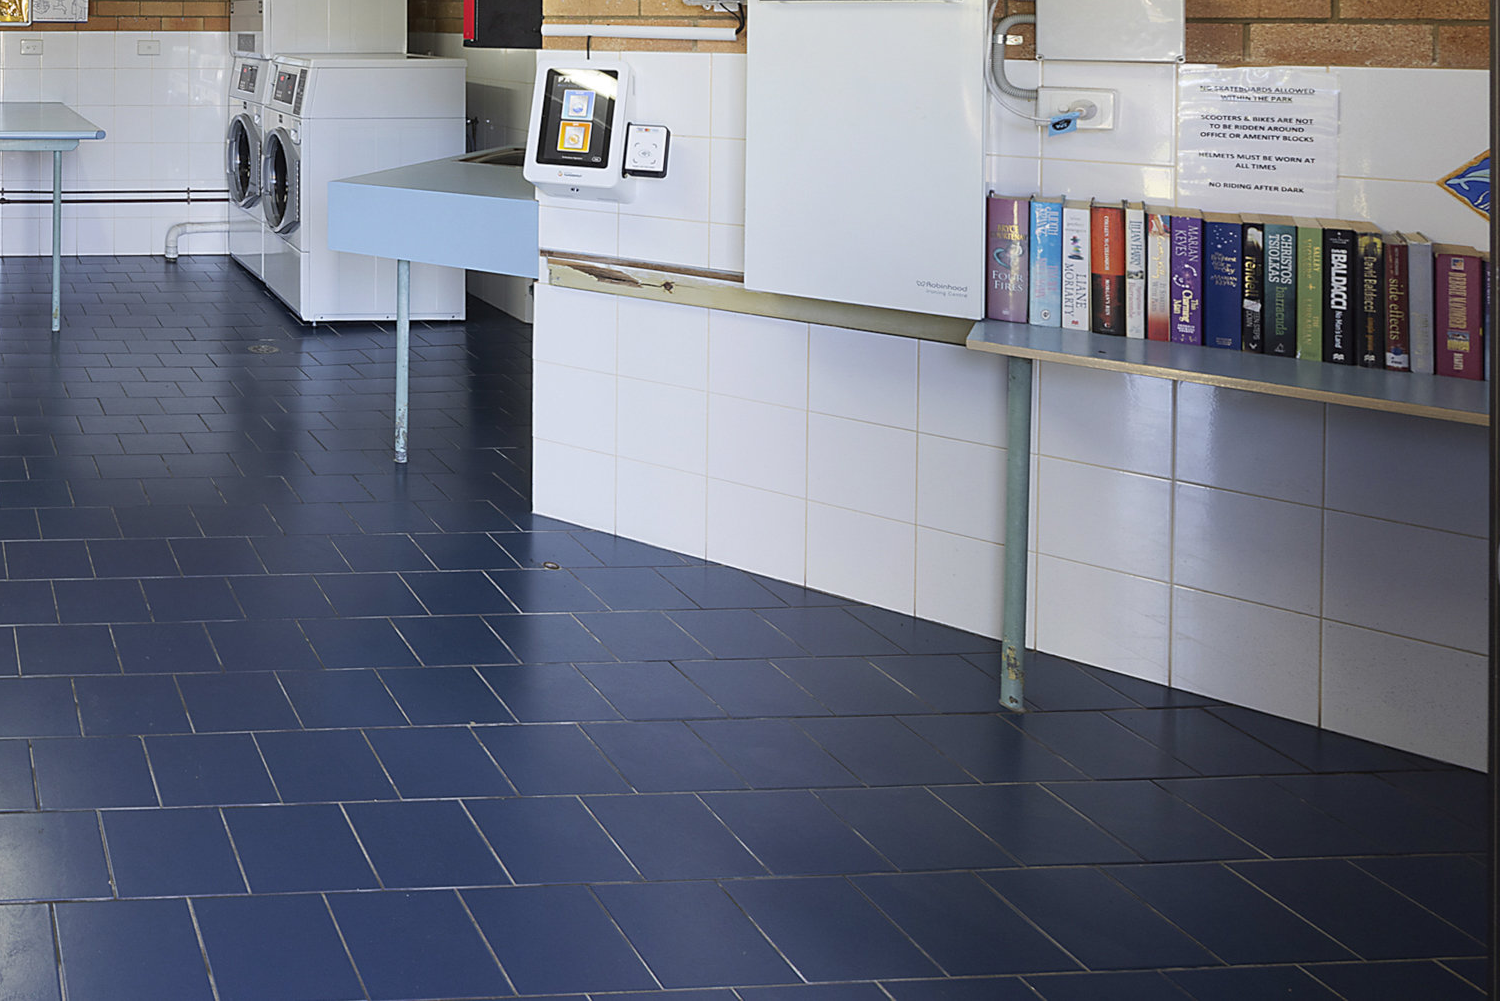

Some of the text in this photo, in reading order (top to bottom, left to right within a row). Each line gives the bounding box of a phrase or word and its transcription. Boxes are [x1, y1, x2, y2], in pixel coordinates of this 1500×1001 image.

[1214, 86, 1272, 94] SKATEBOARDS
[1130, 220, 1142, 267] LILIAN HARRY
[1175, 230, 1187, 257] KEYES
[1188, 226, 1199, 262] MARIAN
[1268, 234, 1280, 283] TSIOLKAS
[1281, 235, 1292, 284] CHRISTOS
[925, 281, 968, 292] Robinhood
[992, 270, 1024, 282] FOUR
[994, 280, 1023, 292] FIRES
[1064, 263, 1075, 317] MORIARTY
[1076, 273, 1087, 309] LIANE
[1244, 256, 1260, 297] rendell
[1331, 254, 1347, 310] BALDACCI
[1364, 256, 1377, 312] David Baldacci
[1389, 278, 1404, 301] side
[1179, 290, 1193, 323] Charming
[1191, 299, 1199, 310] This
[1276, 286, 1288, 335] barracuda
[1389, 304, 1404, 340] effects
[1335, 311, 1343, 348] No Man's Land
